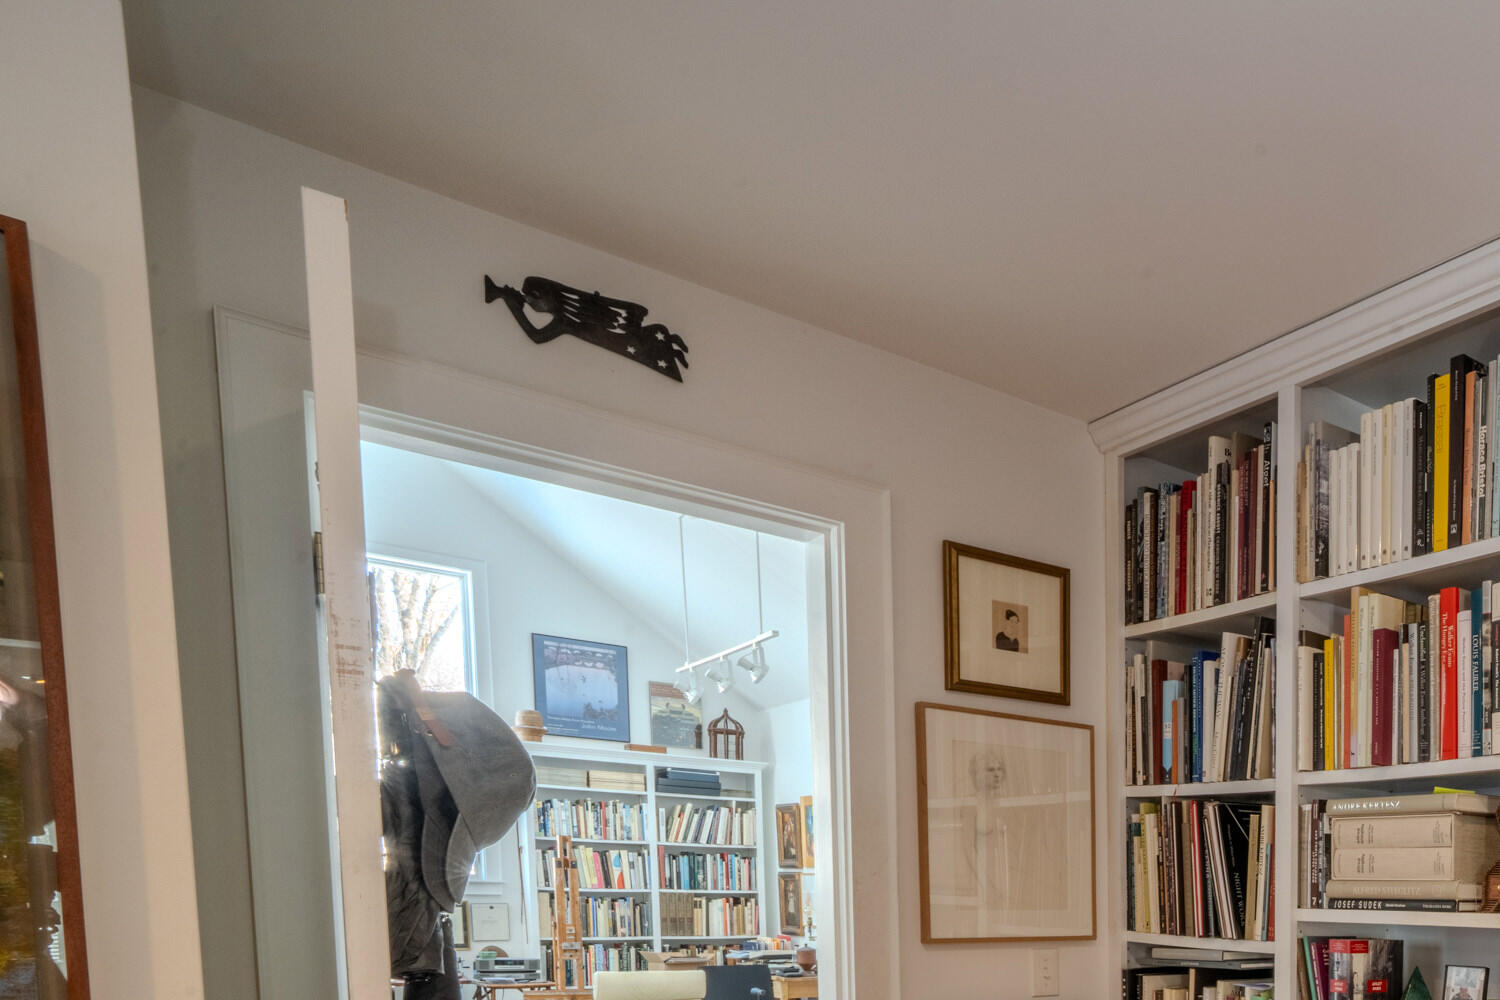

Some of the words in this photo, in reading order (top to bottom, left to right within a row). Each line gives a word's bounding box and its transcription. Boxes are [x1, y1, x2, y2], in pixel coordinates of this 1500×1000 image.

[1478, 425, 1487, 462] Horace
[1477, 463, 1485, 497] Bristol
[1233, 872, 1242, 899] NIGHT
[1333, 900, 1355, 909] JOSEF
[1358, 901, 1382, 910] SUDEK
